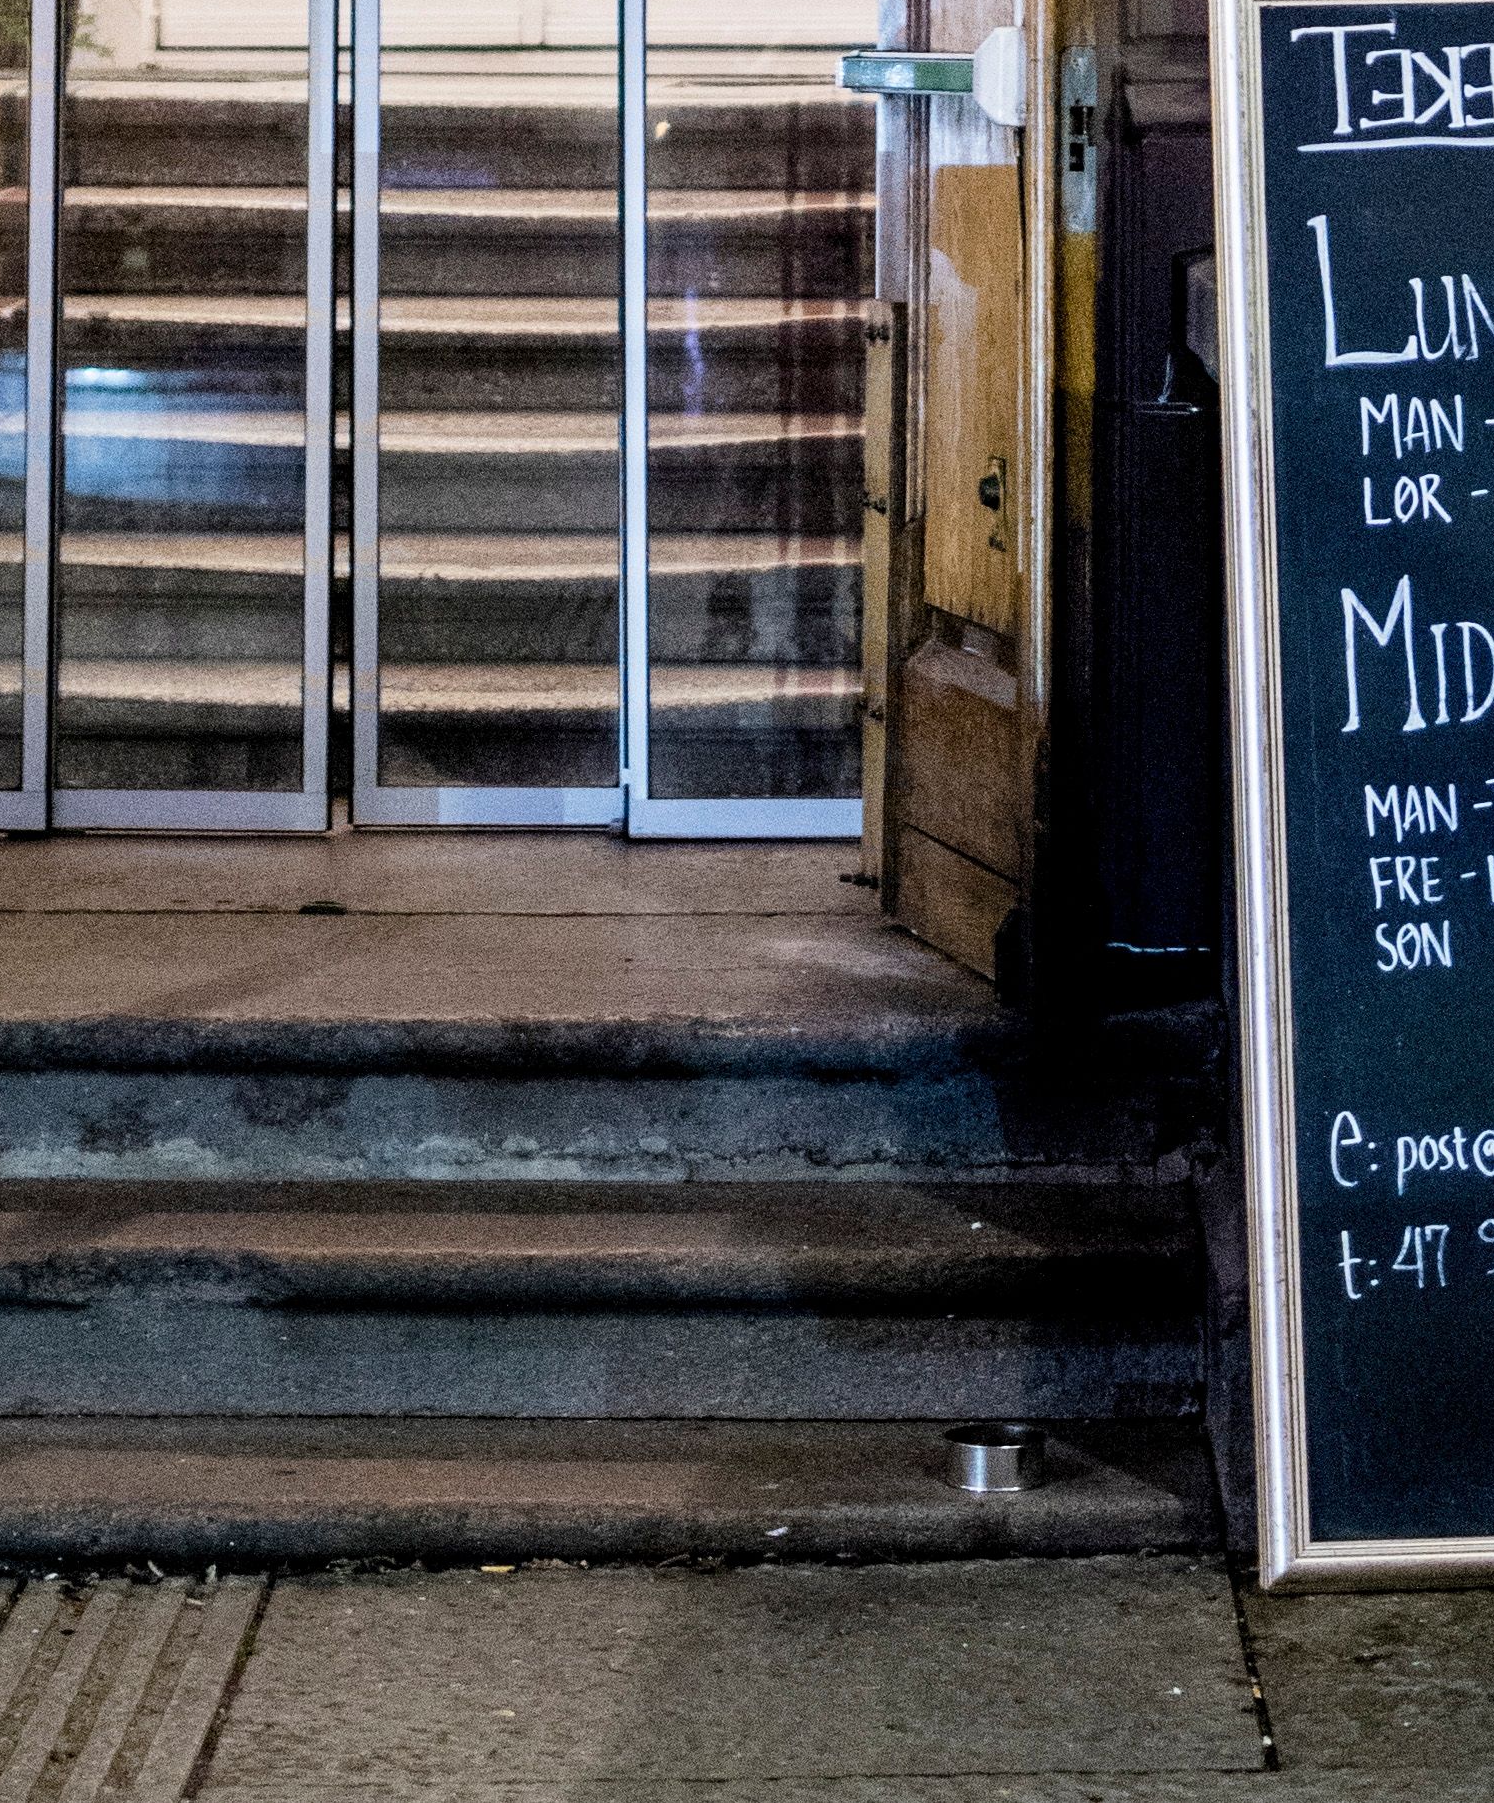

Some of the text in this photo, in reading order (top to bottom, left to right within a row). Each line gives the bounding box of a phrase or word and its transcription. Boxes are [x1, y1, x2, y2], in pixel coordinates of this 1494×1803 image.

[1359, 392, 1465, 460] MAN
[1362, 472, 1453, 527] LØR
[1363, 783, 1459, 843] MAN
[1368, 855, 1444, 910] FRE
[1374, 919, 1453, 973] SØN
[1391, 1224, 1450, 1288] 47
